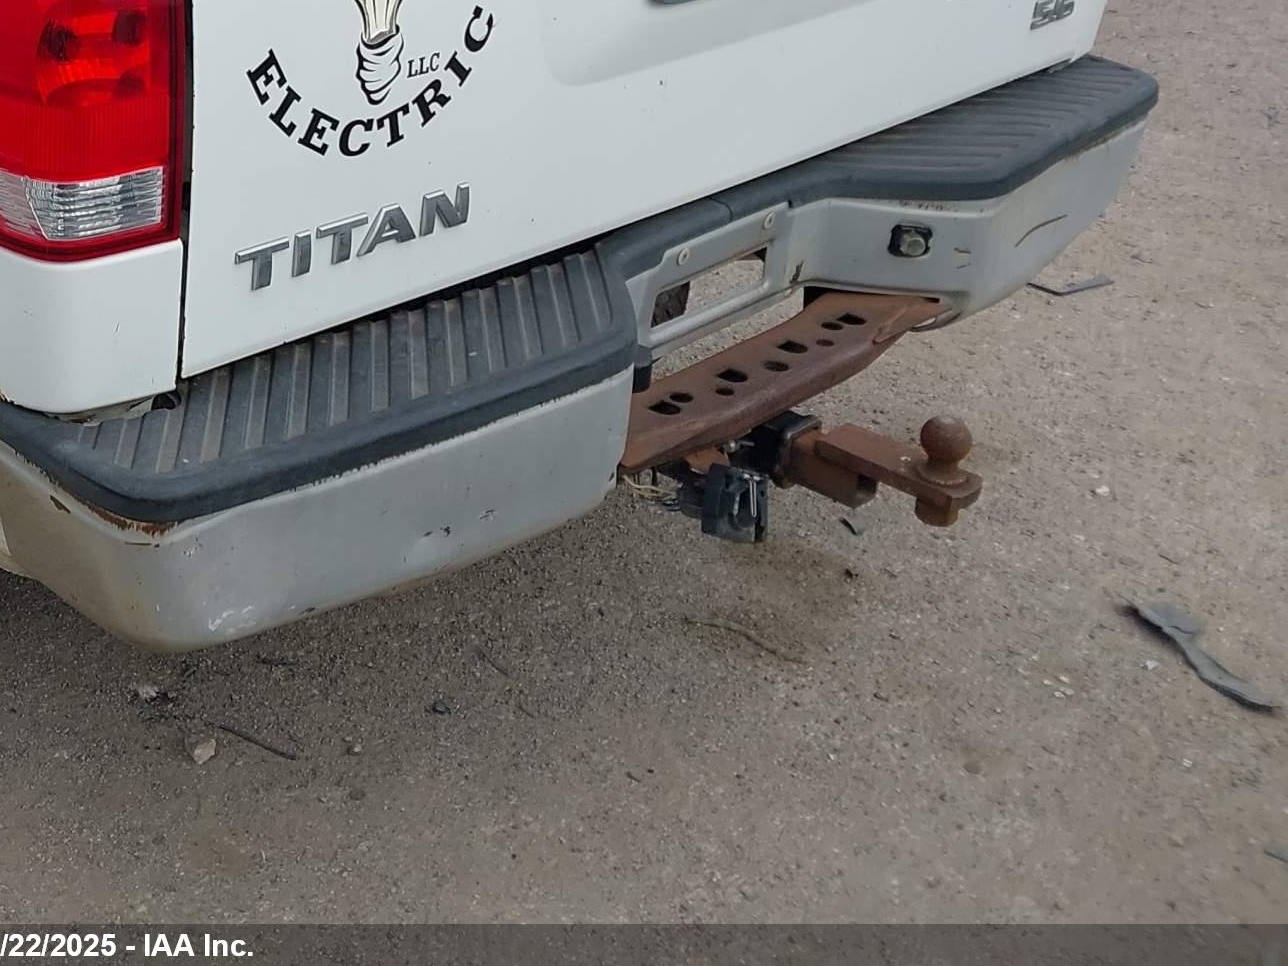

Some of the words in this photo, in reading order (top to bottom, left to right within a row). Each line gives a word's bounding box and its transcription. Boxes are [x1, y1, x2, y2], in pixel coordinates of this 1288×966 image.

[247, 5, 497, 157] ELECTRIC
[407, 52, 440, 79] LLC
[234, 182, 472, 291] TITAN
